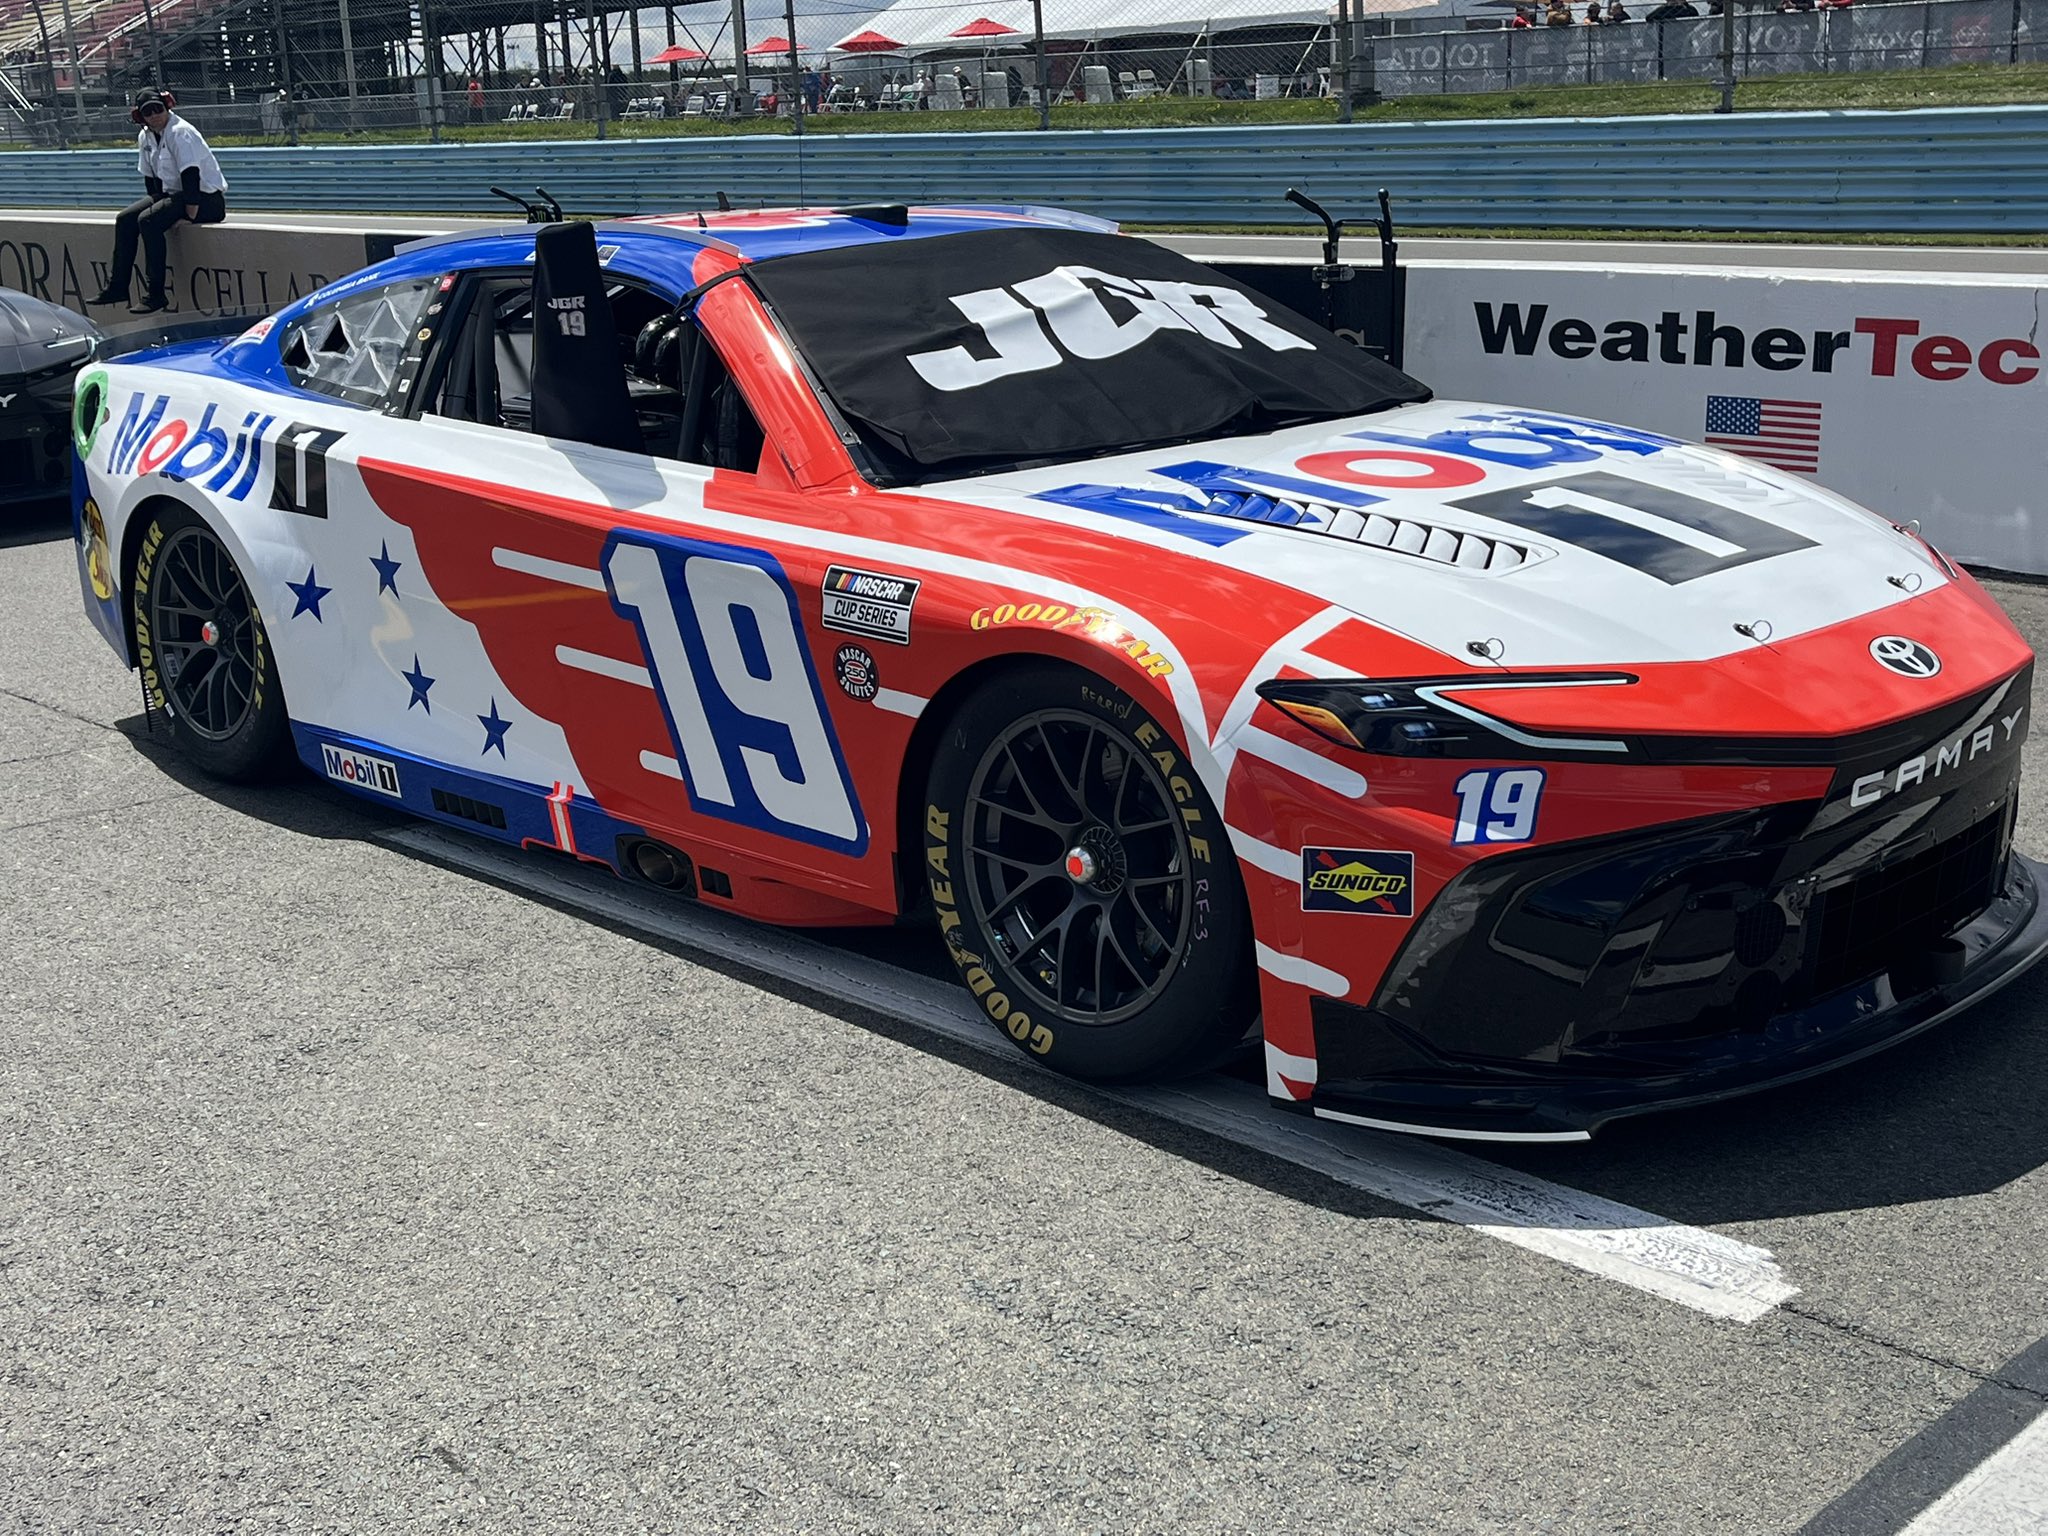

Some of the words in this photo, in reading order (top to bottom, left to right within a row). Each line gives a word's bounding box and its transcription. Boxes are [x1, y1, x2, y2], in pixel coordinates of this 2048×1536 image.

[547, 296, 586, 310] JGR
[557, 310, 586, 337] 19
[906, 265, 1316, 391] JGR
[1474, 301, 2041, 386] WeatherTec
[107, 392, 277, 501] Mobil
[1026, 410, 1690, 547] Mobil
[133, 519, 164, 709] GOODYEAR
[833, 598, 858, 619] CUP
[857, 604, 898, 628] SERIES
[849, 575, 905, 601] NASCAR
[838, 647, 872, 669] NASCAR
[846, 667, 866, 679] 250
[969, 603, 1175, 679] GOODYAR
[607, 541, 860, 843] 19
[839, 675, 875, 698] SALUTES
[324, 748, 378, 788] Mobil
[1134, 720, 1211, 864] EAGLE
[1455, 769, 1544, 843] 19
[1312, 872, 1405, 893] SUNOCO
[927, 803, 1054, 1055] GOODYEAR
